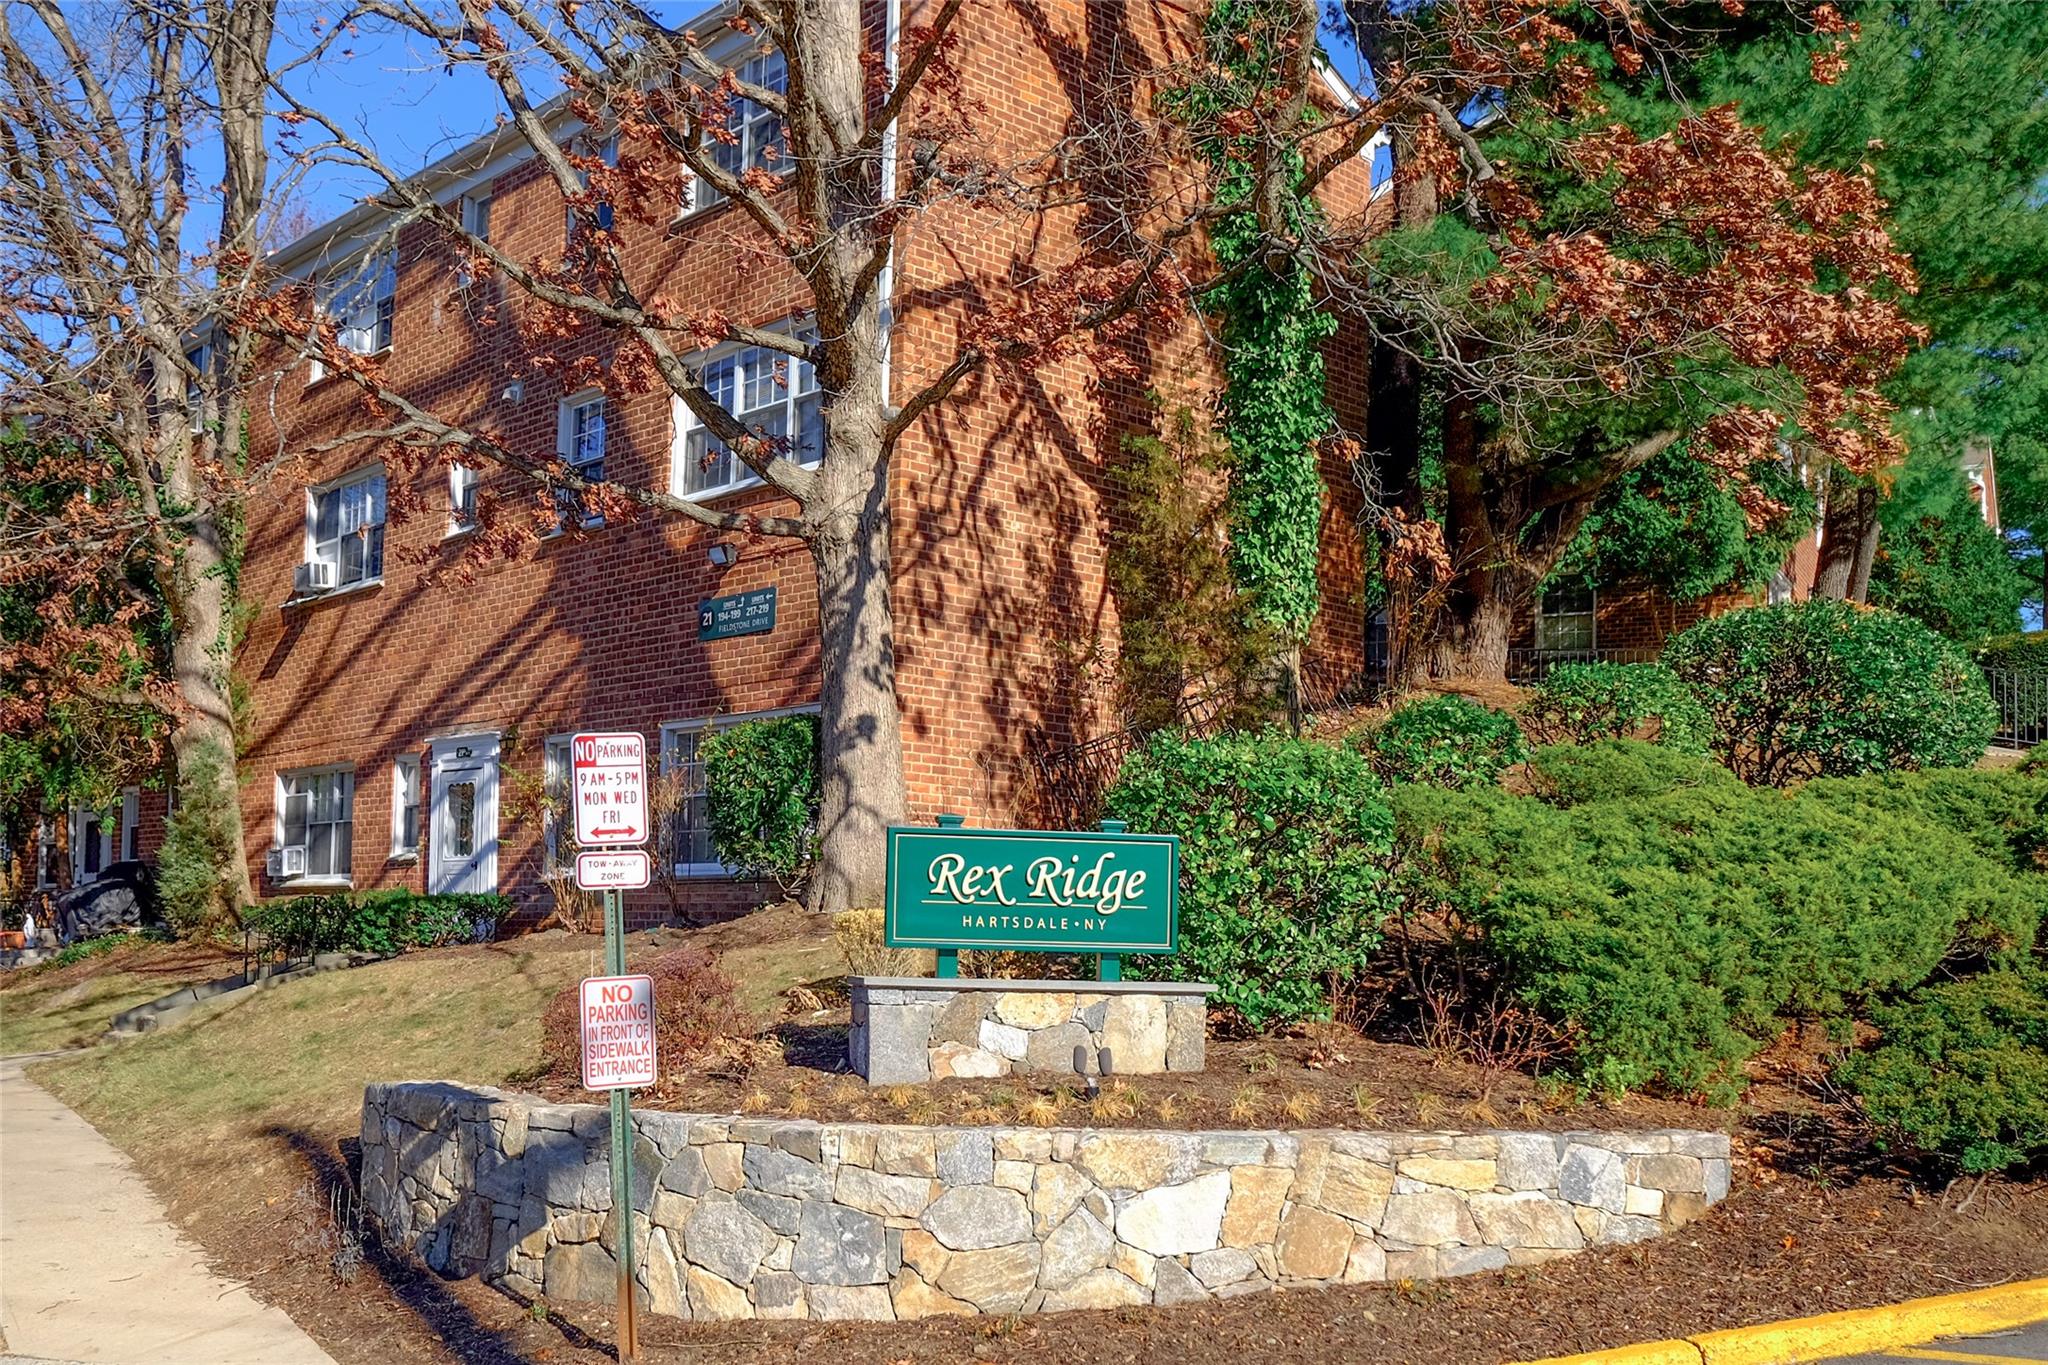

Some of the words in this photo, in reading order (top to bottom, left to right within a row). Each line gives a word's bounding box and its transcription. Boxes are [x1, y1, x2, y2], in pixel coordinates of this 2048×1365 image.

[703, 611, 712, 626] 21
[719, 620, 750, 632] FIELDSTONE
[752, 617, 768, 626] DRIVE
[575, 740, 595, 762] NO
[597, 743, 640, 758] PARKING
[580, 772, 587, 787] 9
[584, 791, 607, 806] MON
[614, 790, 637, 804] WED
[602, 810, 620, 824] FRI
[600, 872, 624, 881] ZONE
[928, 853, 1017, 906] Rex
[1026, 851, 1147, 915] Ridge
[962, 915, 1068, 930] HARTSDALE
[1084, 919, 1107, 931] NY
[602, 985, 633, 1003] NO
[589, 1003, 648, 1024] PARKING
[588, 1026, 598, 1042] IN
[601, 1024, 633, 1041] FRONT
[636, 1023, 649, 1038] OF
[589, 1040, 650, 1060] SIDEWALK
[589, 1058, 652, 1077] ENTRANCE
